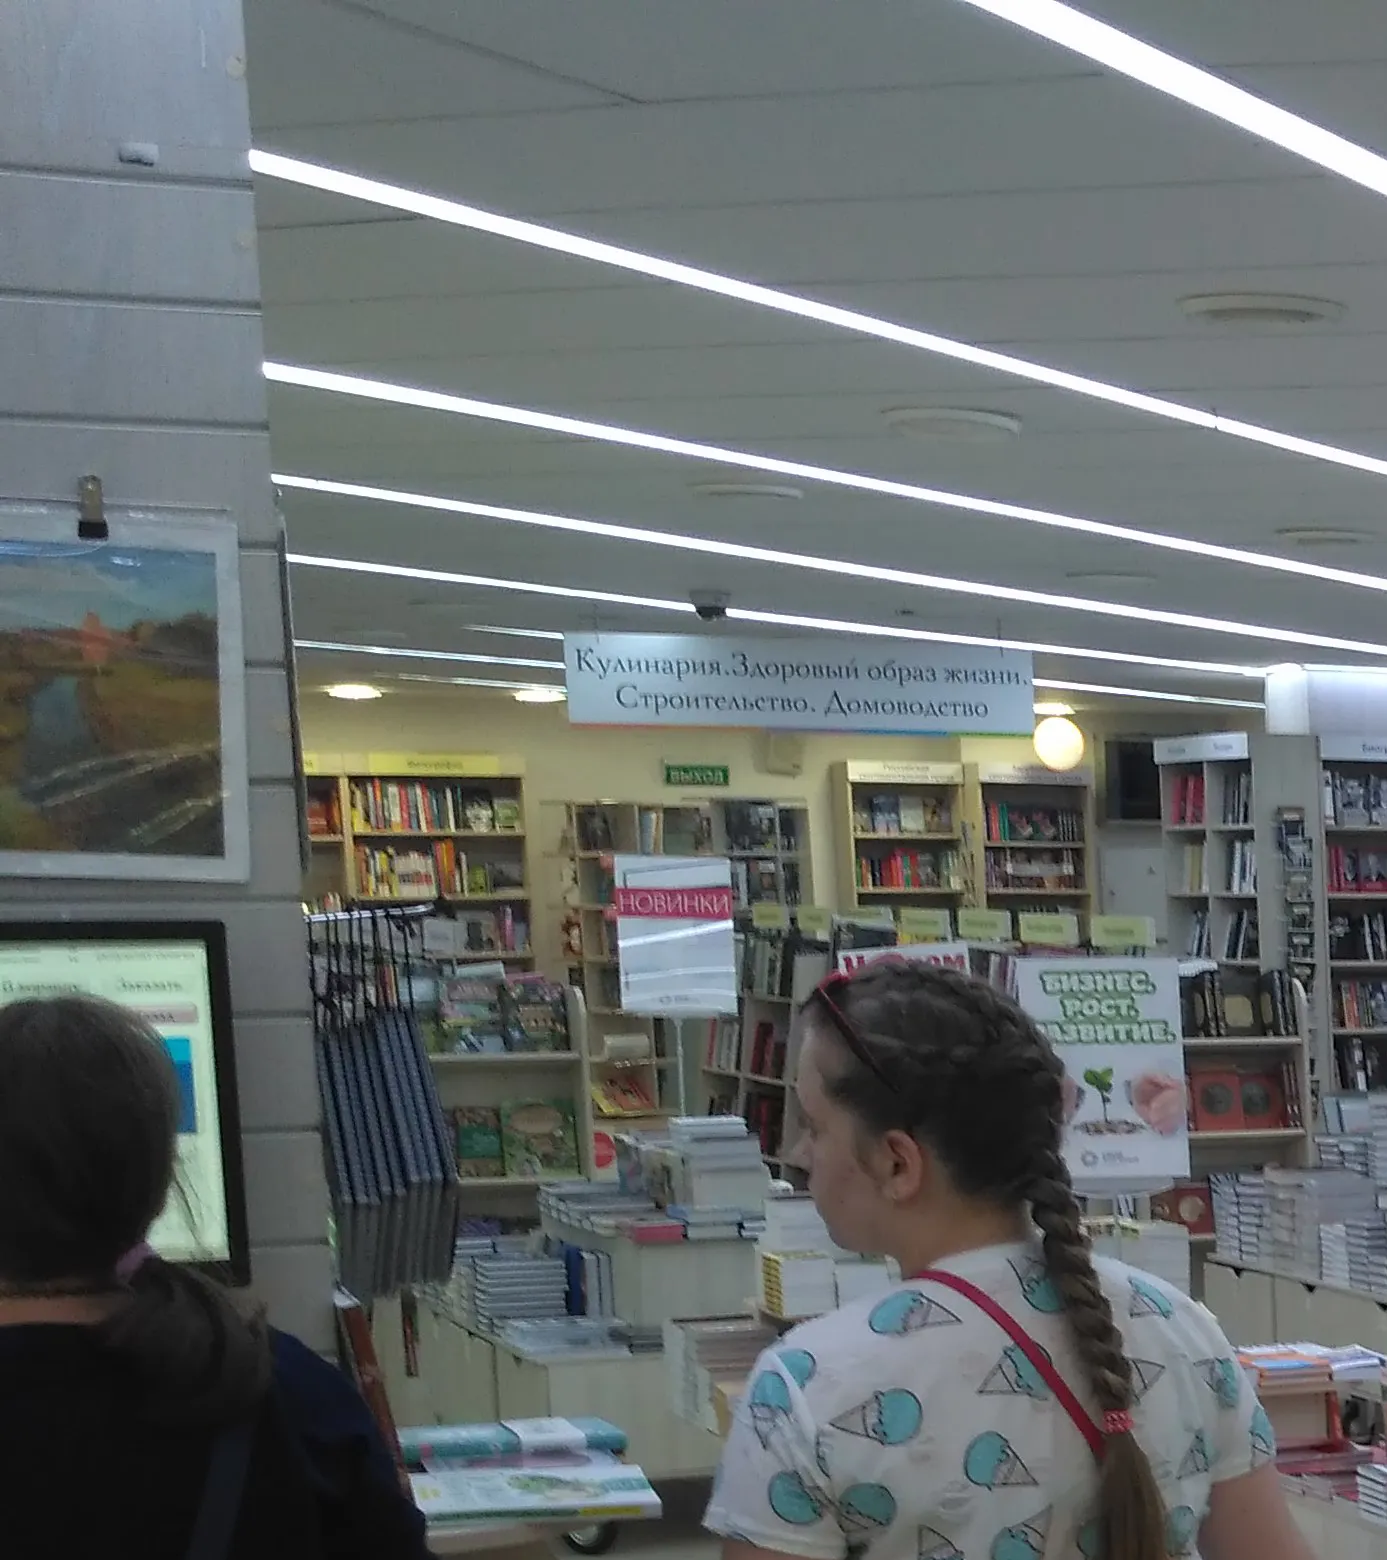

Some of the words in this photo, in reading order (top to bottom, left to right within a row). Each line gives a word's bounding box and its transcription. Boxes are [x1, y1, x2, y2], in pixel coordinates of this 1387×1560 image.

[867, 658, 937, 687] образ
[944, 666, 1028, 686] жизни.
[615, 683, 816, 715] Строительство.
[824, 690, 989, 719] Домоводство
[618, 891, 730, 915] НОВИНКИ
[1041, 970, 1157, 994] БИЗНЕС.
[1060, 998, 1139, 1019] РОСТ.
